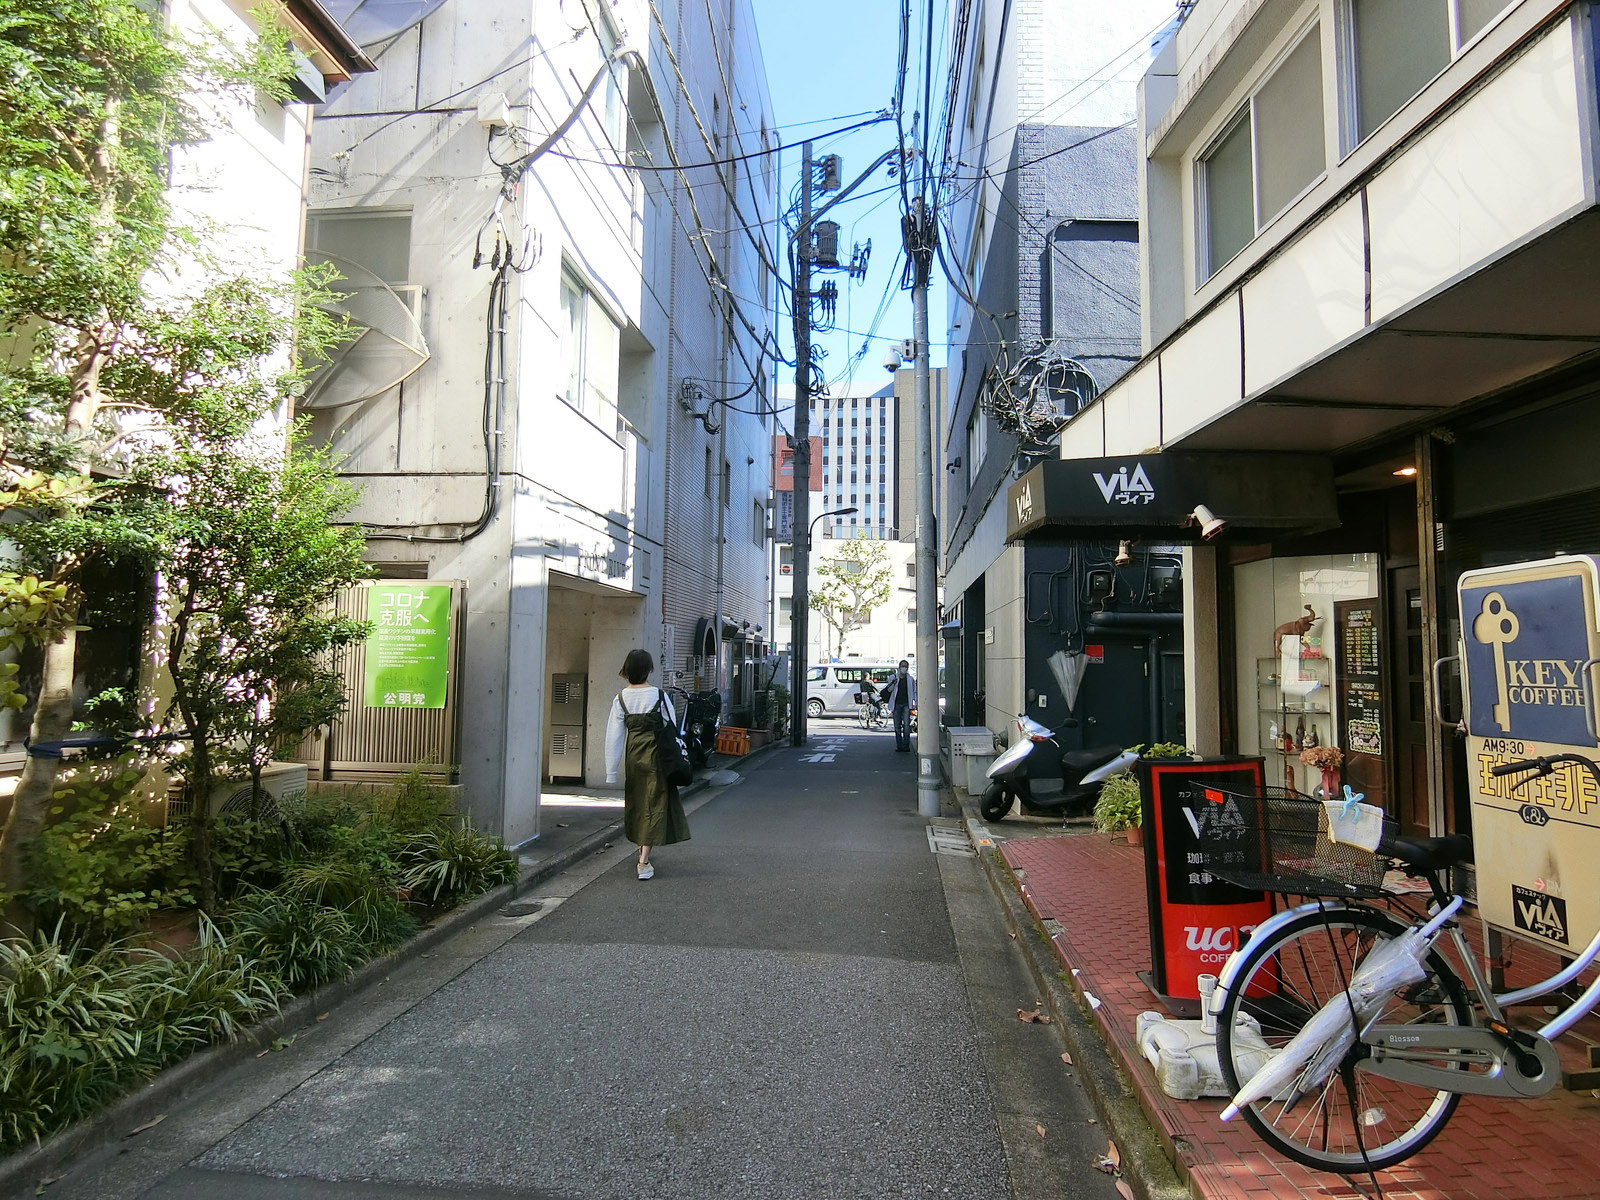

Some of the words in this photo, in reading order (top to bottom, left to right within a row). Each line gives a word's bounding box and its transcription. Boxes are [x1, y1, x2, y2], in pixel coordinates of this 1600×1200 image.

[1115, 491, 1155, 505] ヴィア
[380, 590, 430, 609] コロナ
[379, 609, 430, 626] 克服へ
[1507, 660, 1583, 688] KEY
[384, 692, 425, 705] 公明党
[1509, 687, 1585, 706] COFFEE
[1483, 739, 1524, 755] AM9:30
[1535, 922, 1565, 940] ヴィア
[1200, 953, 1232, 963] COFF
[1389, 1034, 1420, 1043] Blossom
